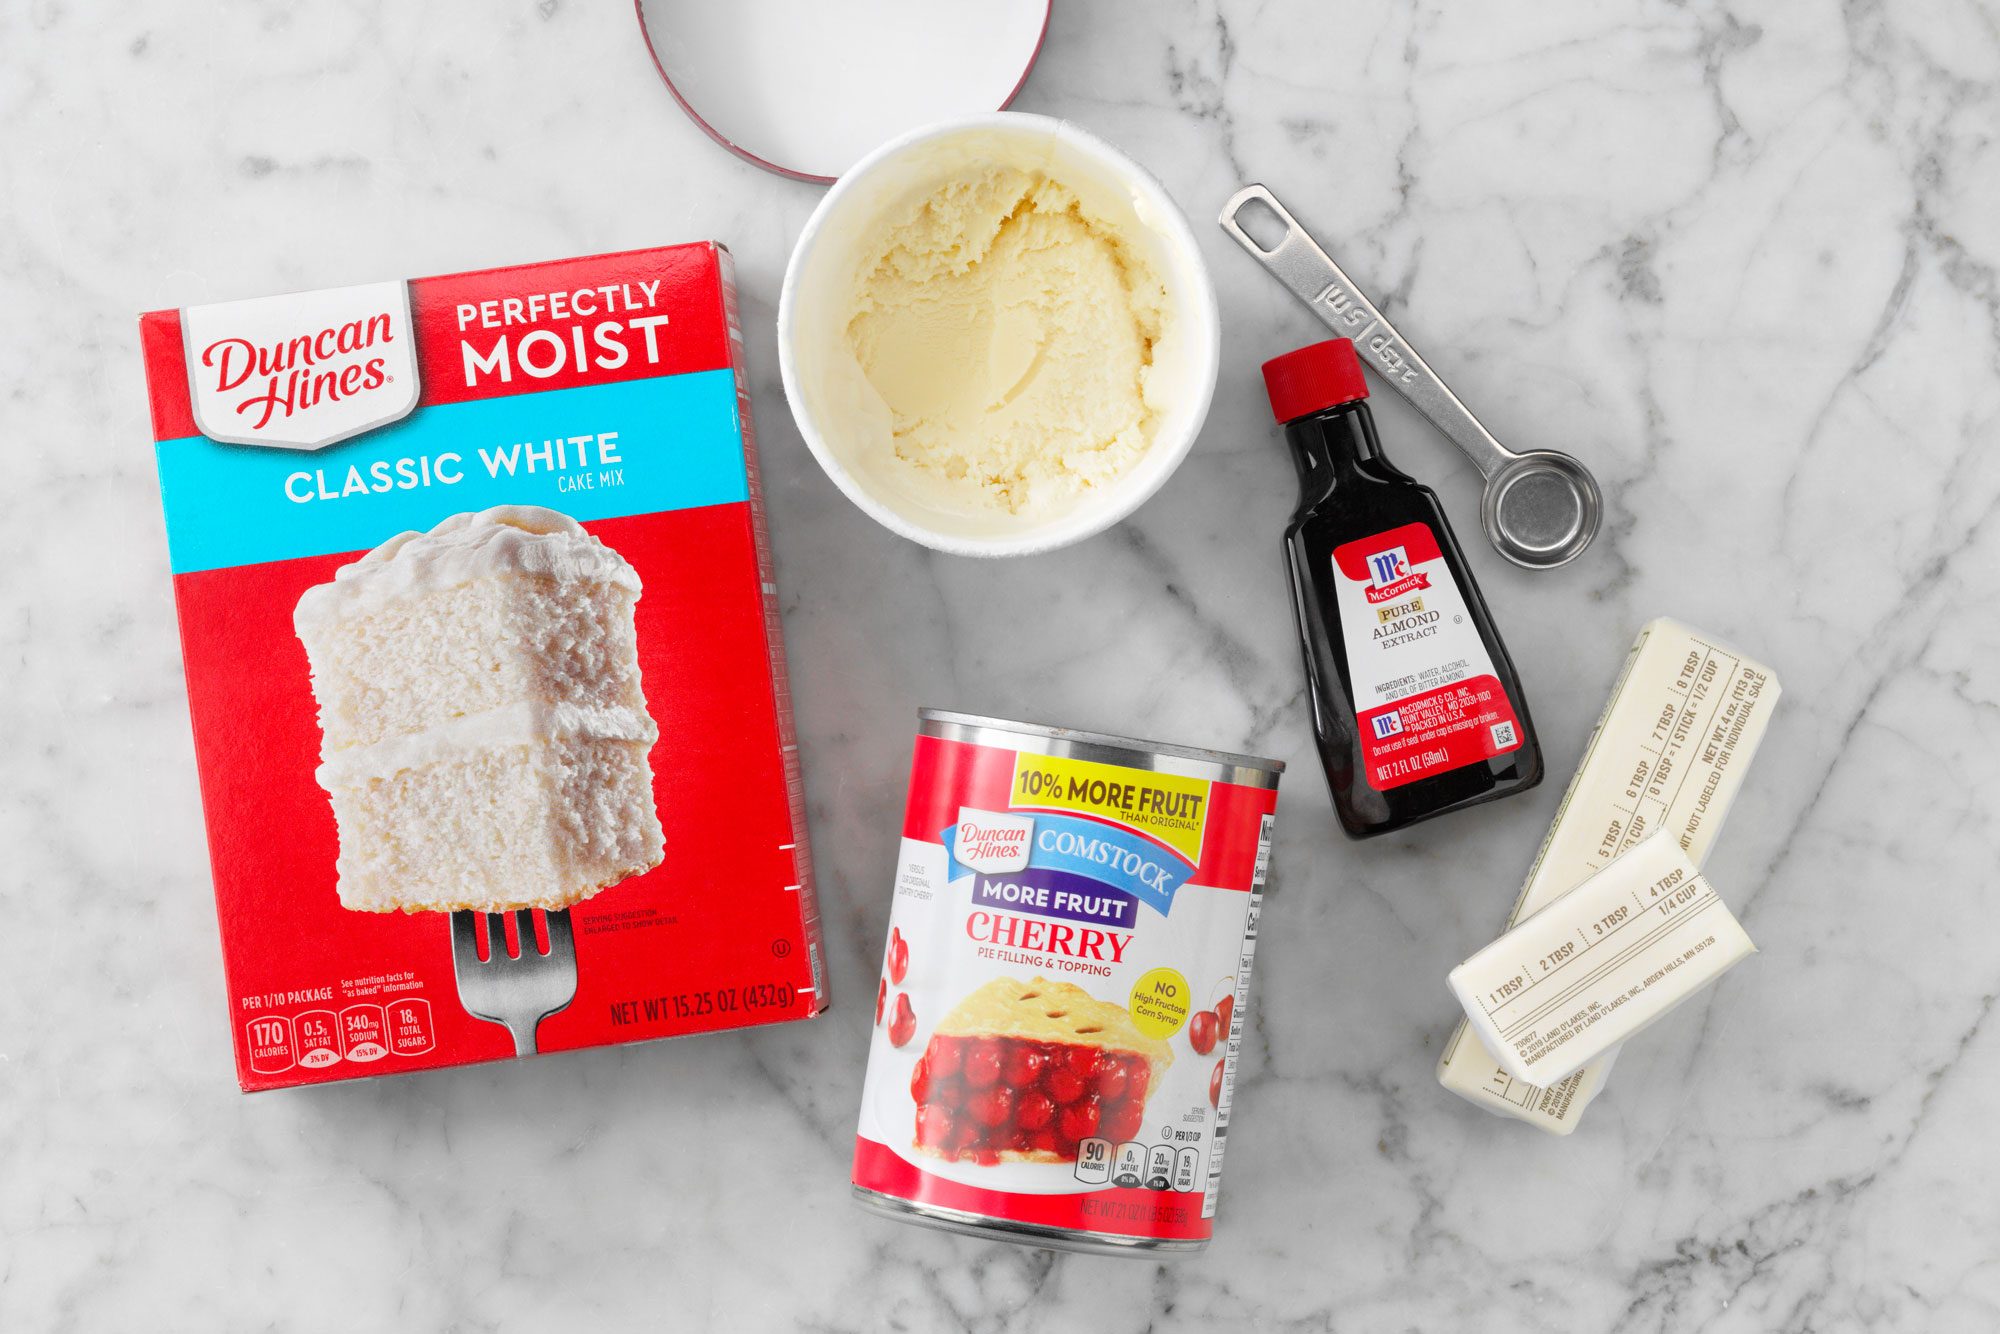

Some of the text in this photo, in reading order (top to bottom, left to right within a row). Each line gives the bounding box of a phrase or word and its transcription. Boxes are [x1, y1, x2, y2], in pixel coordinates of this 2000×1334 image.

[457, 279, 661, 331] PERFECTLY
[202, 311, 394, 394] Duncan
[460, 314, 669, 388] MOIST
[236, 355, 386, 431] Hines
[284, 431, 622, 504] CLASSIC WHITE
[557, 468, 625, 494] CAKE MIX
[1368, 575, 1423, 602] McCormick
[1381, 600, 1421, 621] PURE
[1372, 610, 1440, 640] ALMOND
[1381, 625, 1438, 649] EXTRACT
[1676, 650, 1700, 689] 8 TBSP
[1375, 674, 1417, 694] INGREDIENTS:
[1385, 677, 1439, 701] AND OIL OF BITTER
[1398, 687, 1471, 716] McCORMICK INC.
[1401, 713, 1421, 726] HUNT
[1447, 700, 1459, 711] MD
[1459, 690, 1492, 709] 21031-1100
[1411, 716, 1447, 734] PACKED IN
[1649, 659, 1719, 796] 8 TBSP STICK 1/2 CUP
[1652, 703, 1676, 741] 7 TBSP
[1701, 667, 1756, 765] NET WT. 4 oz. (113 g)
[1372, 710, 1500, 757] Do not use seal under cap missing broken.
[1376, 747, 1449, 781] NET 2 FL OZ (59mL)
[1685, 672, 1767, 834] NOT LABELED FOR INDIVIDUAL SALE
[1625, 760, 1650, 799] 6 TBSP
[1020, 770, 1203, 820] 10% MORE FRUIT
[1120, 810, 1148, 824] THAN
[1629, 815, 1647, 838] CUP
[961, 822, 1026, 844] Duncan
[1598, 819, 1622, 858] 5 TBSP
[966, 842, 1019, 861] Hines
[1038, 829, 1173, 895] COMSTOCK
[1649, 867, 1685, 898] 4 TBSP
[982, 879, 1128, 919] MORE FRUIT
[1658, 884, 1698, 916] 1/4 CUP
[582, 914, 613, 926] SERVING
[584, 916, 678, 936] ENLARGED SHOW DETAIL
[1592, 904, 1630, 936] 3 TBSP
[966, 911, 1134, 964] CHERRY
[978, 946, 1112, 977] PIE FILLING & TOPPING
[1539, 941, 1575, 971] 2 TBSP
[340, 971, 415, 988] See nutrition facts for
[383, 981, 424, 993] information
[1154, 981, 1176, 998] NO
[1495, 975, 1524, 998] TBSP
[242, 987, 334, 1010] PER 1/10 PACKAGE
[610, 981, 795, 1026] NET WT 15.25 OZ (432g)
[1134, 991, 1187, 1016] High Fructose
[1524, 1028, 1575, 1067] MANUFACTURED
[1573, 1023, 1584, 1034] BY
[1583, 1014, 1602, 1028] LAND
[1643, 969, 1666, 989] ARDEN
[1663, 957, 1686, 974] HILLS,
[1682, 948, 1696, 962] MN
[1694, 935, 1716, 954] 55126
[345, 1014, 379, 1032] 340mg
[1136, 1005, 1179, 1027] Corn Syrup
[1526, 1038, 1544, 1054] 2019
[1542, 1027, 1561, 1042] LAND
[1587, 1001, 1603, 1014] INC.
[253, 1021, 285, 1047] 170
[304, 1036, 331, 1048] SAT FAT
[349, 1030, 379, 1043] SODIUM
[397, 1035, 427, 1048] SUGARS
[399, 1025, 422, 1036] TOTAL
[1513, 1030, 1538, 1050] 700677
[254, 1045, 289, 1059] CALORIES
[310, 1052, 330, 1063] 3% DV
[355, 1047, 378, 1057] 15% DV
[1538, 1087, 1554, 1112] 700677
[1551, 1088, 1564, 1108] 2019
[1175, 1130, 1186, 1140] PER
[1085, 1142, 1104, 1161] 90
[1080, 1161, 1105, 1172] CALORIES
[1120, 1163, 1139, 1172] SAT FAT
[1152, 1166, 1169, 1176] SODIUM
[1180, 1168, 1191, 1177] TOTAL
[1177, 1177, 1192, 1186] SUGARS
[1080, 1198, 1115, 1217] NET WT
